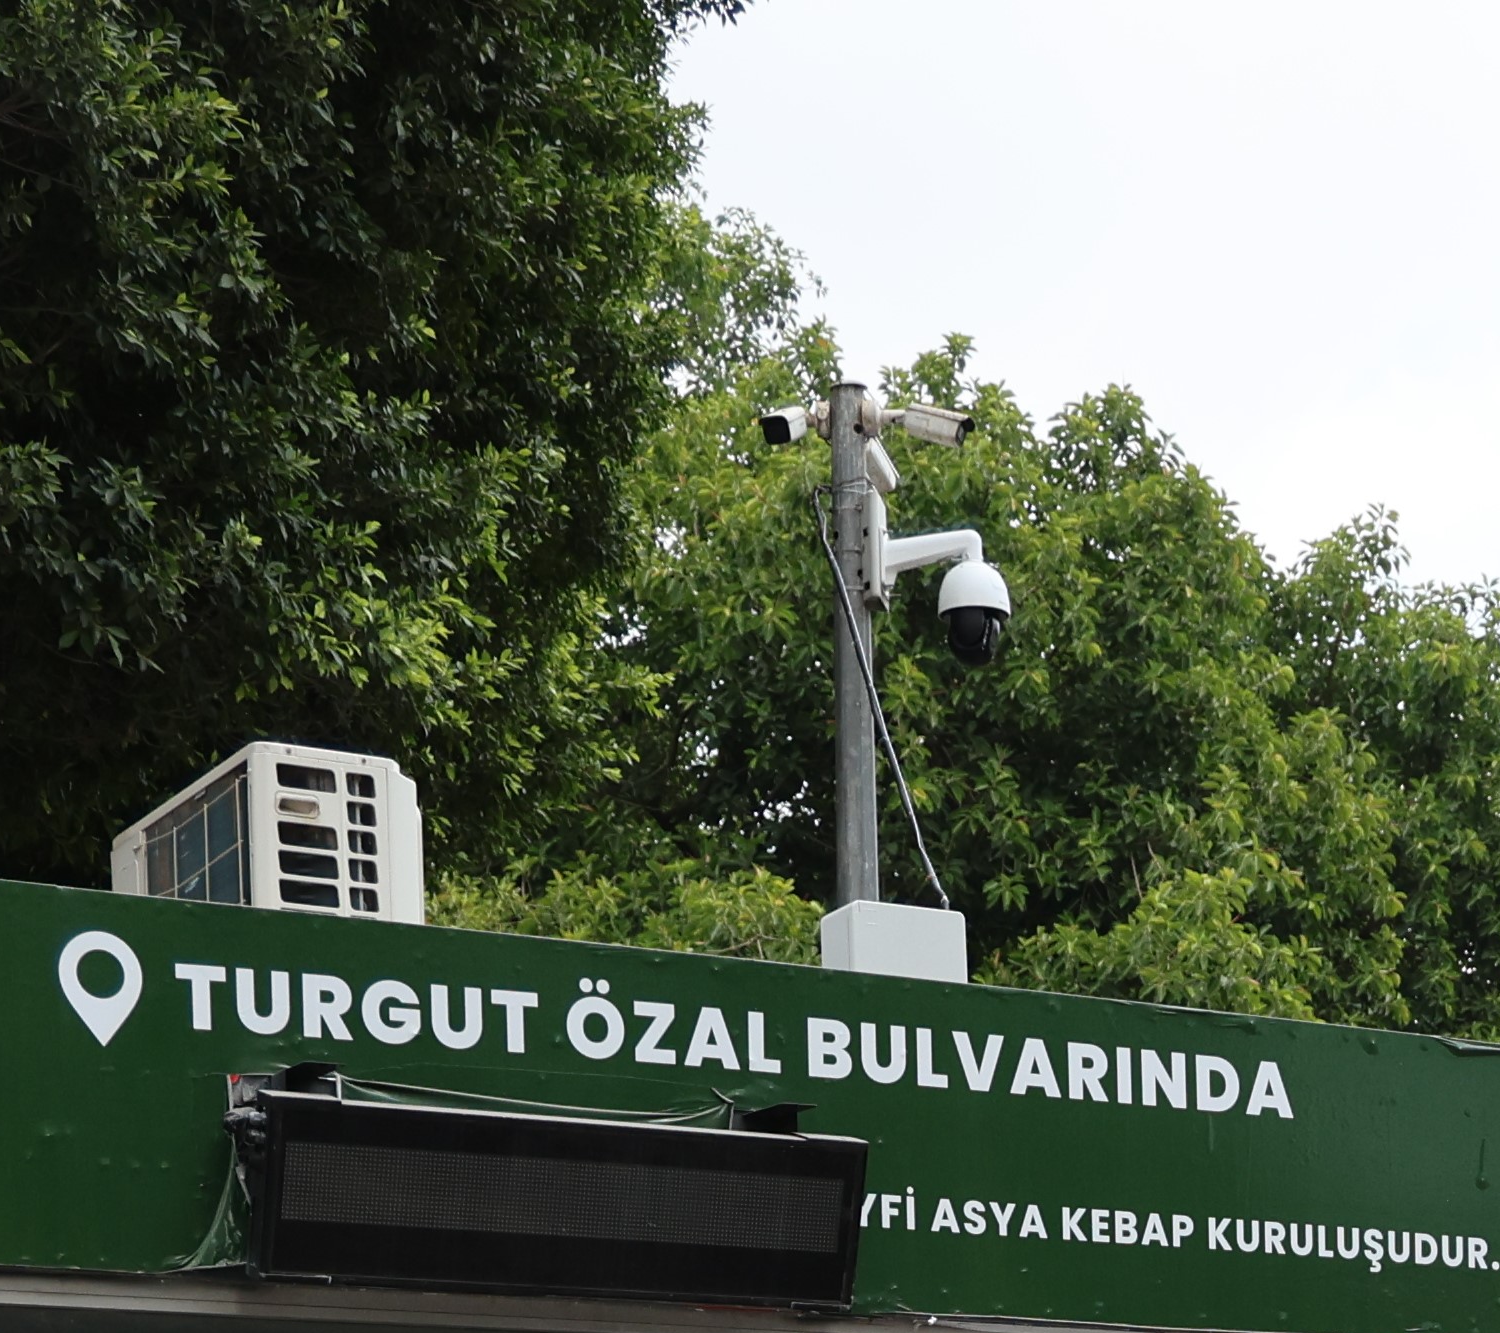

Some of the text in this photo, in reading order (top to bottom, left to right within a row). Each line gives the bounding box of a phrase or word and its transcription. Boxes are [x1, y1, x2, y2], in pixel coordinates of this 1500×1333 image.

[175, 961, 1296, 1120] TURGUT ÖZAL BULVARINDA
[860, 1186, 1500, 1275] YFİ ASYA KEBAP KURULUŞUDUR.
